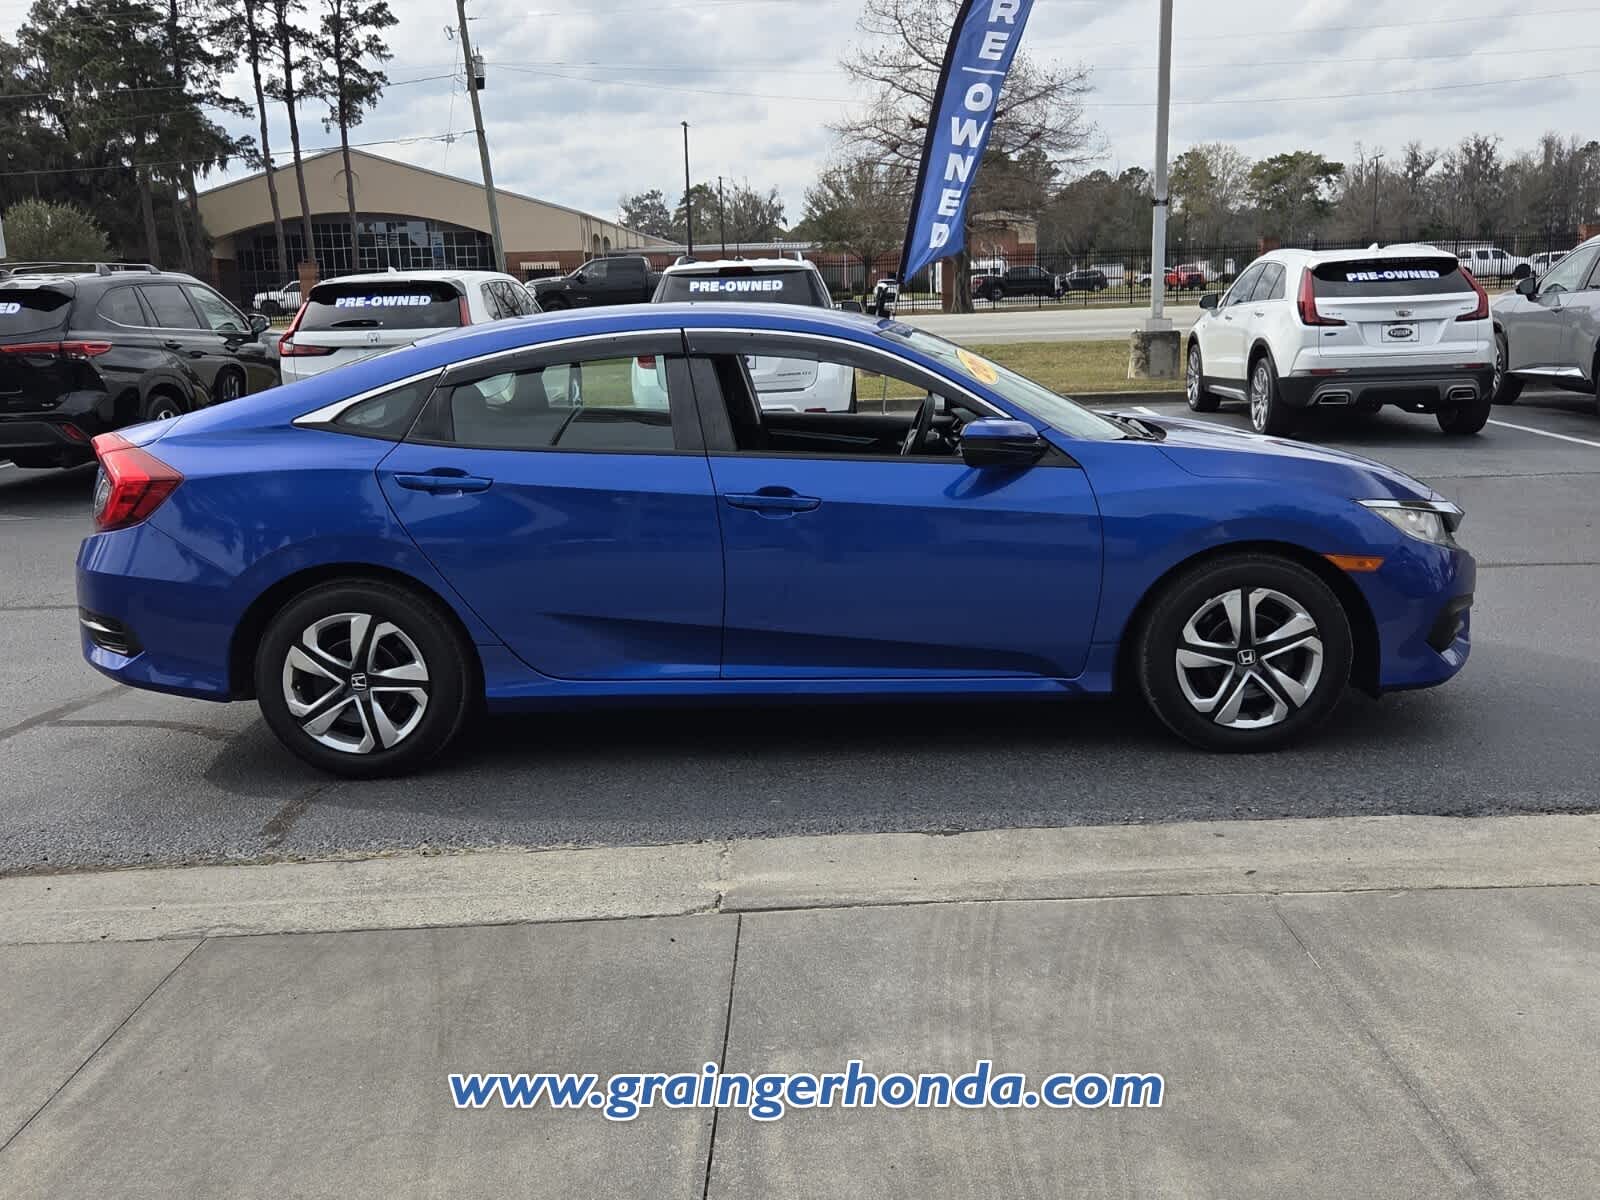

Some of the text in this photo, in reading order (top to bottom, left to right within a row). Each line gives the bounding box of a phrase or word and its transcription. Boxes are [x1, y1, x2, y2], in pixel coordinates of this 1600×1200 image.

[1346, 270, 1440, 281] PRE-OWNED
[689, 280, 783, 292] PRE-OWNED
[335, 295, 432, 308] PRE-OWNED
